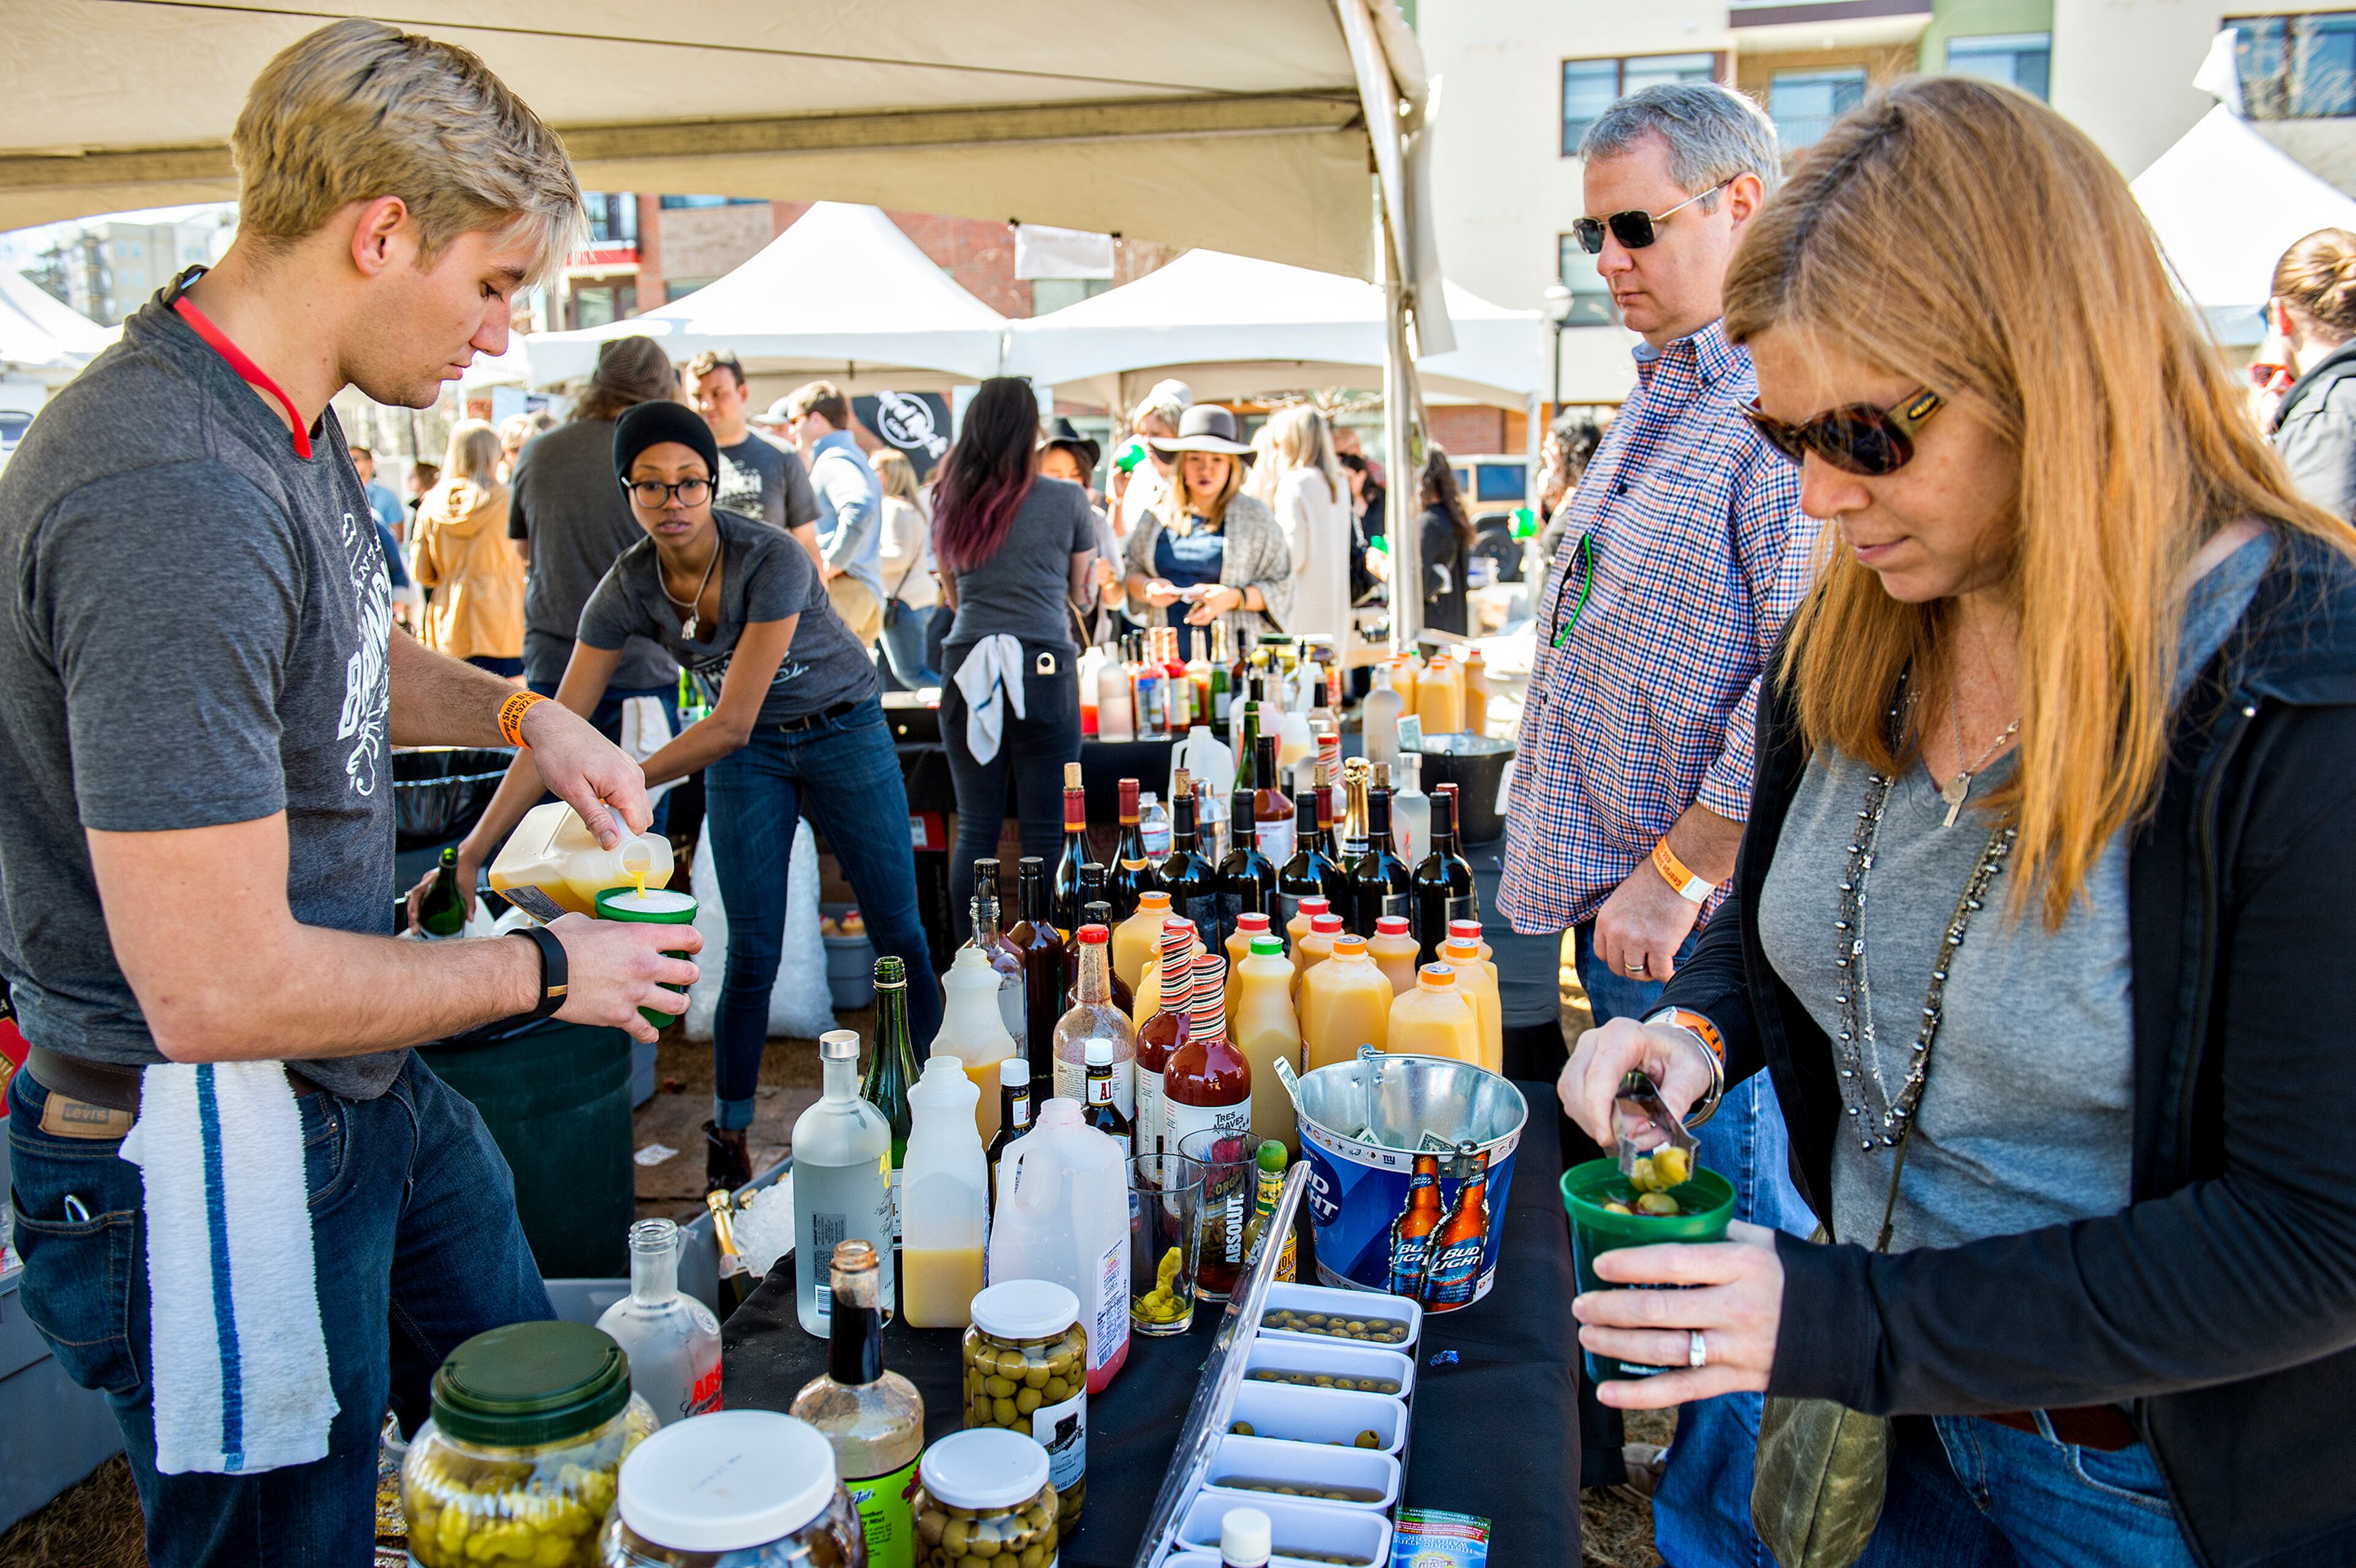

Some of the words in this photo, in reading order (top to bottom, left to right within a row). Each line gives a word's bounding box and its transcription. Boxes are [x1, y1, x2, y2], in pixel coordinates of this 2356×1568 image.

[1212, 1114, 1244, 1134] AGAVES
[1215, 1111, 1236, 1126] TRES
[1441, 1247, 1480, 1260] BUD
[1431, 1256, 1480, 1272] LIGHT
[1423, 1542, 1473, 1554] HISTORIC
[1438, 1537, 1467, 1548] WARD
